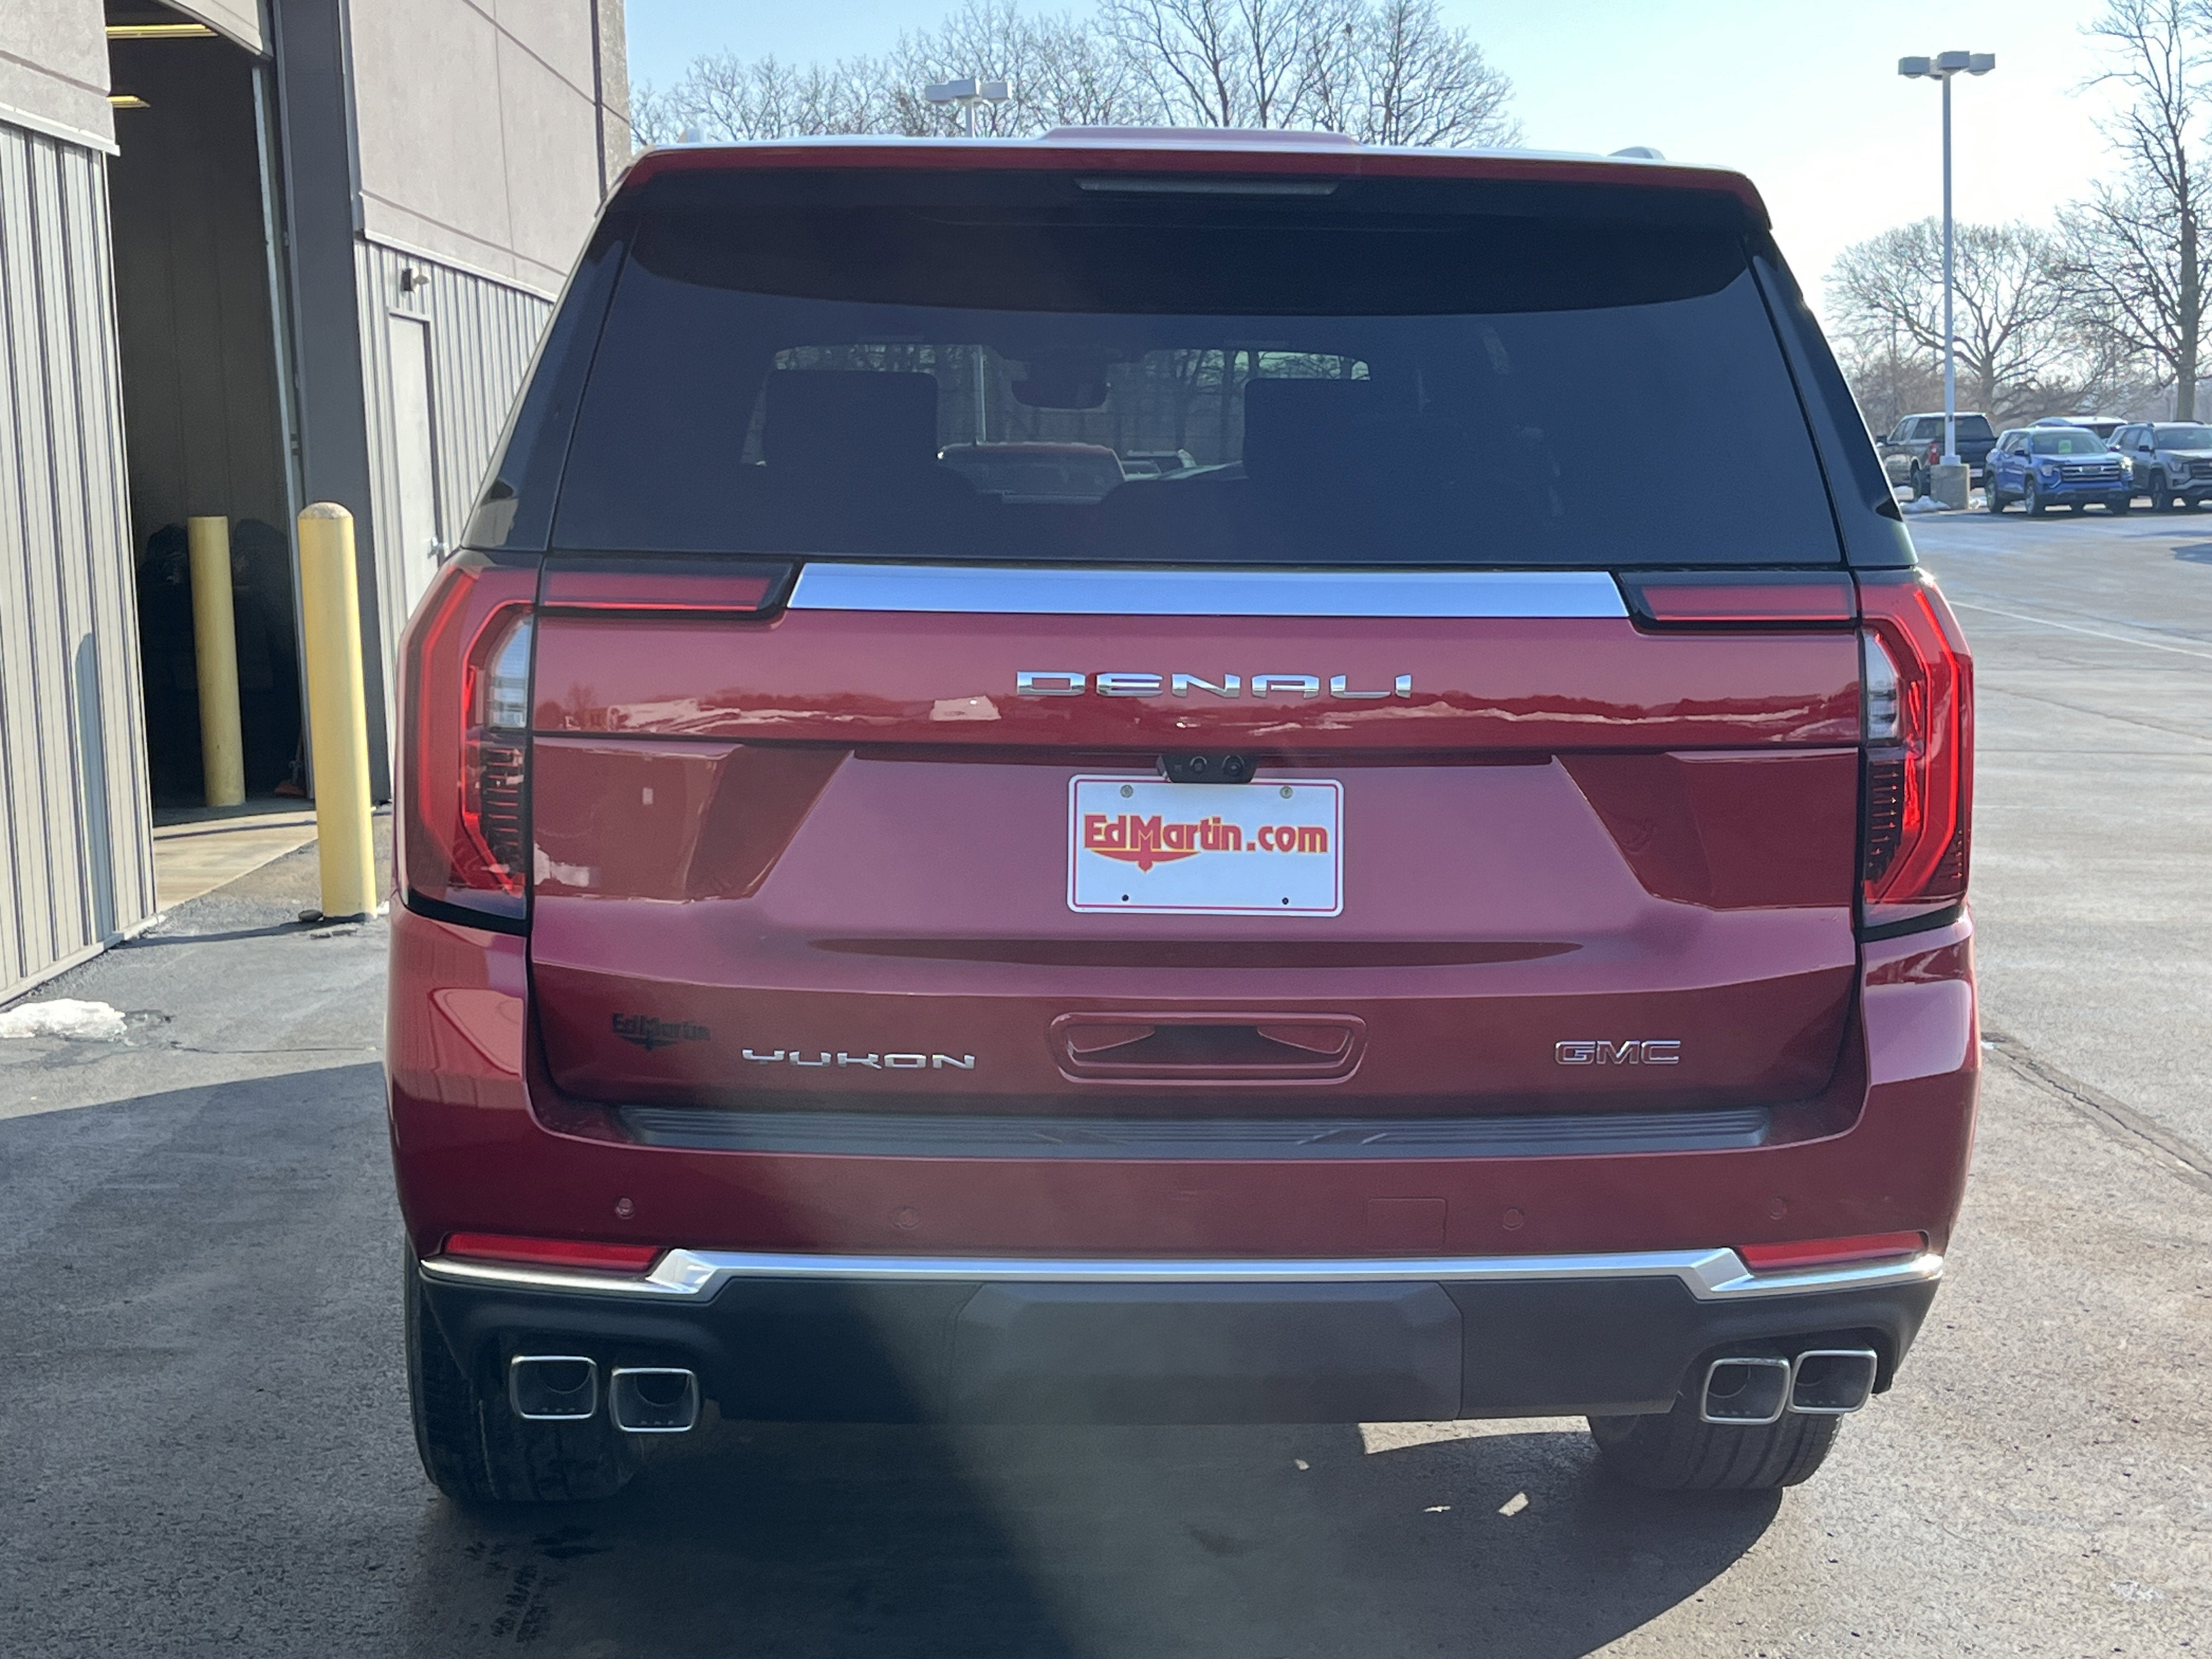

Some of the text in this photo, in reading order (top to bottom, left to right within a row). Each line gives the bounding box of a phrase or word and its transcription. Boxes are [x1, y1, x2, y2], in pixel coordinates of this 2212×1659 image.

[1017, 671, 1412, 698] DENALI
[1084, 814, 1328, 861] EdMartin.com
[742, 1048, 975, 1069] YUKON
[1555, 1040, 1681, 1065] GMC
